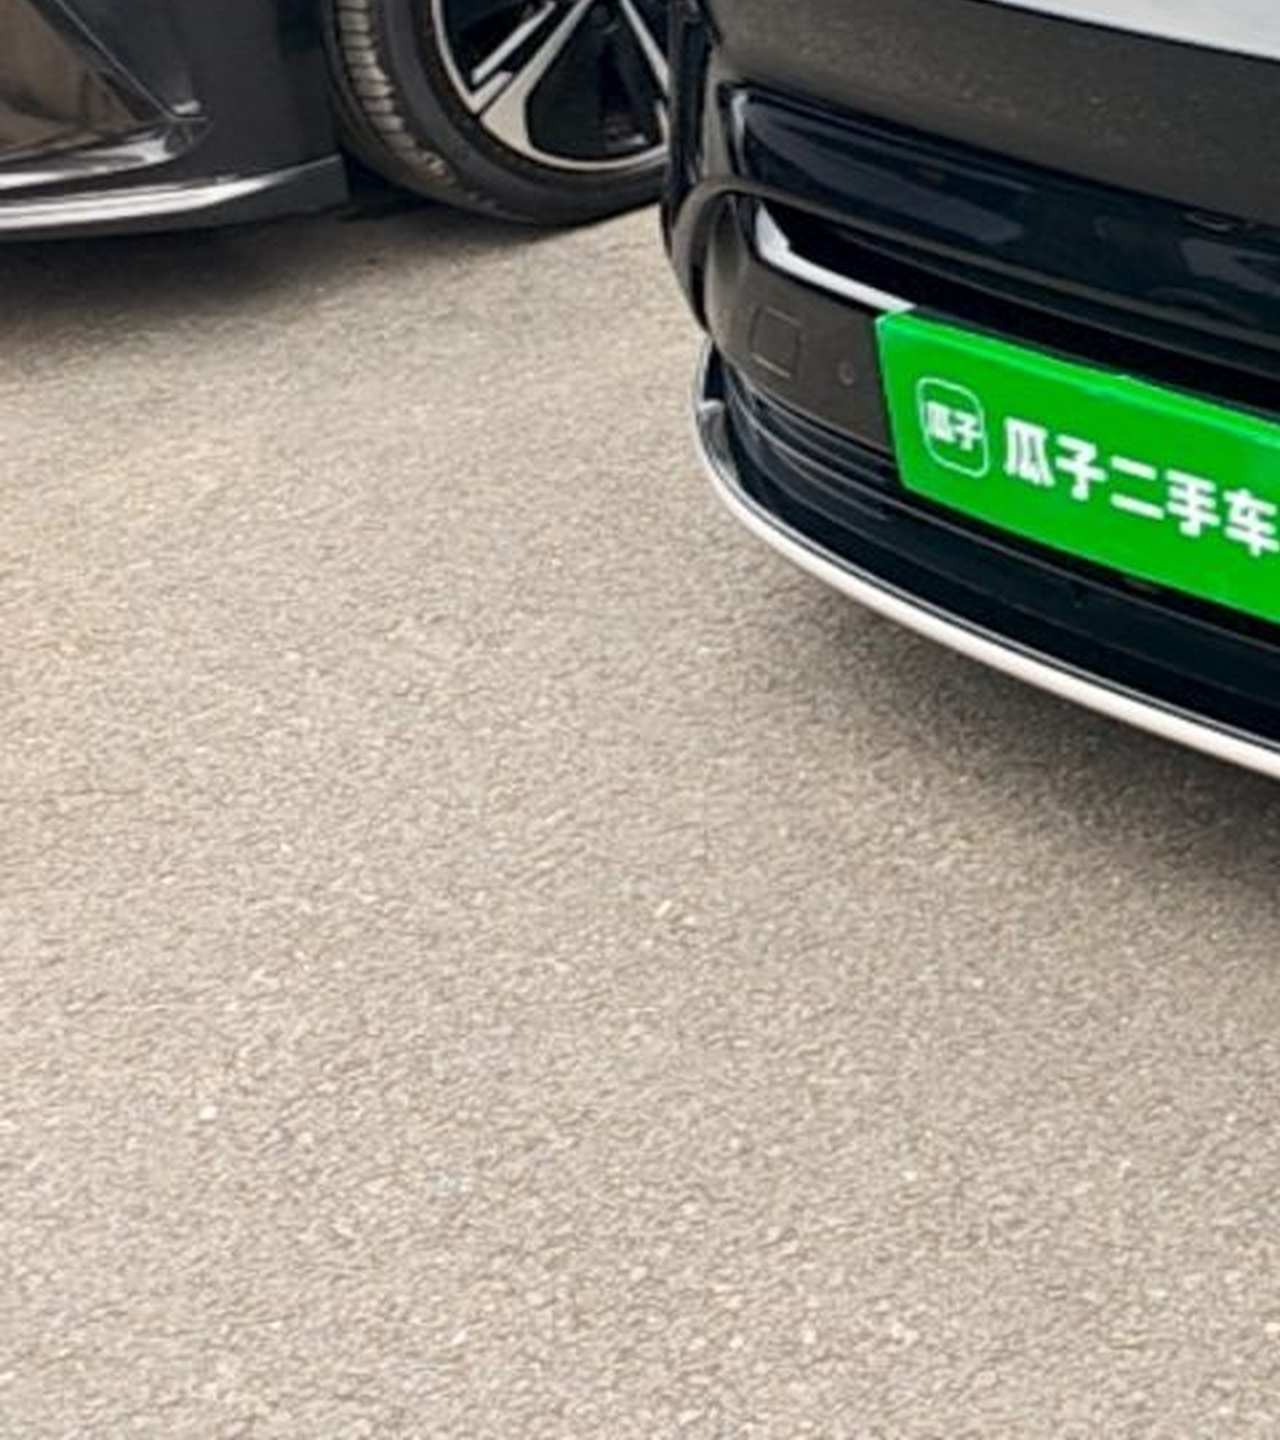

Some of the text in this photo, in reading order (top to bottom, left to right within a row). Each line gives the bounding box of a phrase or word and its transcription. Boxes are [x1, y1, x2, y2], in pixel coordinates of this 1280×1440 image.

[926, 401, 984, 451] 瓜子
[1003, 416, 1280, 558] 瓜子二手车
